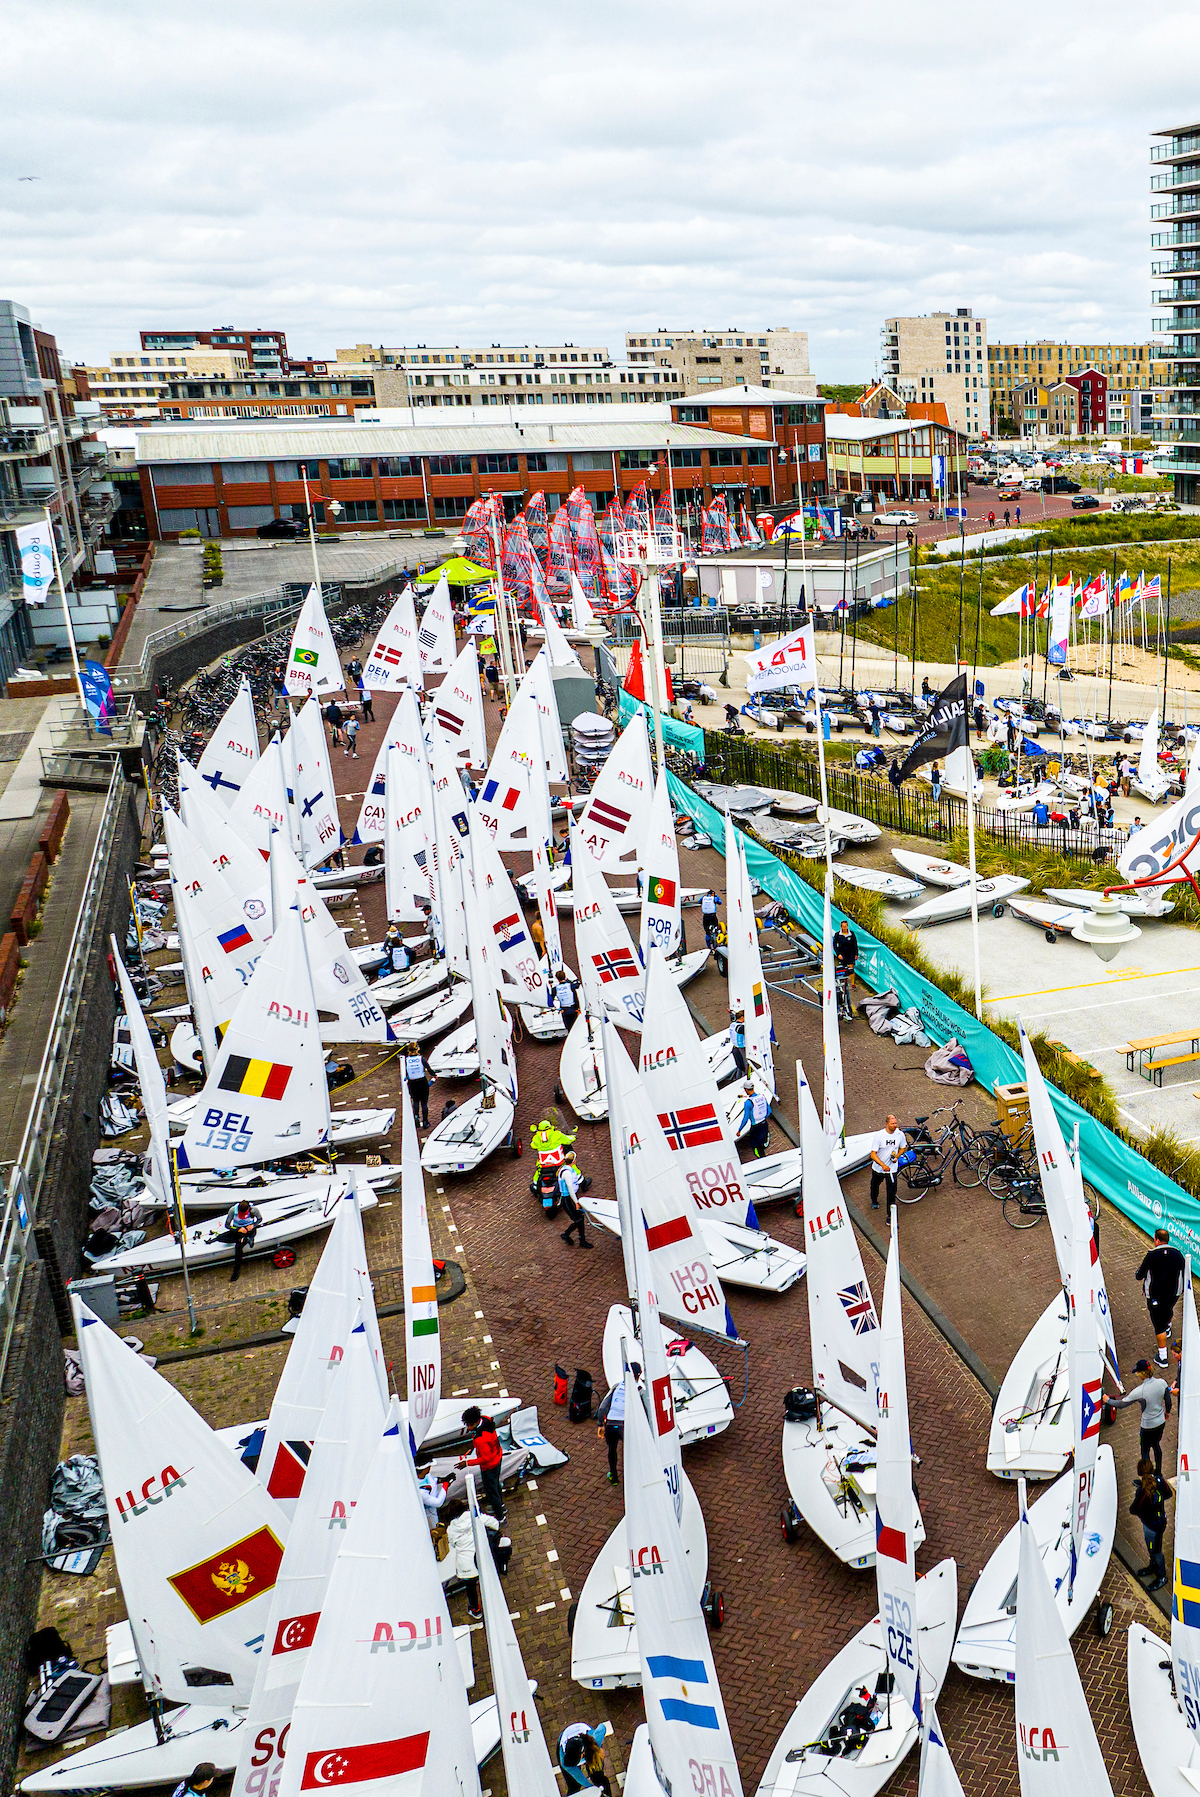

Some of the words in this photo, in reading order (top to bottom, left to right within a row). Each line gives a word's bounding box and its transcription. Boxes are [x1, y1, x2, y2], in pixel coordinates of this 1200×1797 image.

[30, 537, 42, 592] Roompot
[289, 670, 312, 682] BRA
[367, 664, 390, 679] DEN
[396, 806, 422, 831] ILCA
[319, 823, 337, 844] FIN
[581, 829, 610, 850] AT
[326, 895, 344, 904] FIN
[575, 902, 602, 924] ILCA
[648, 917, 672, 936] POR
[355, 1006, 382, 1028] TPE
[643, 1046, 678, 1073] ILCA
[202, 1107, 254, 1135] BEL
[692, 1182, 745, 1211] NOR
[1127, 1178, 1152, 1211] Allianz
[809, 1205, 845, 1241] ILCA
[682, 1285, 720, 1315] CHI
[413, 1363, 435, 1393] IND
[115, 1464, 188, 1523] ILCA
[887, 1626, 914, 1670] CZE
[1019, 1722, 1060, 1762] ILCA
